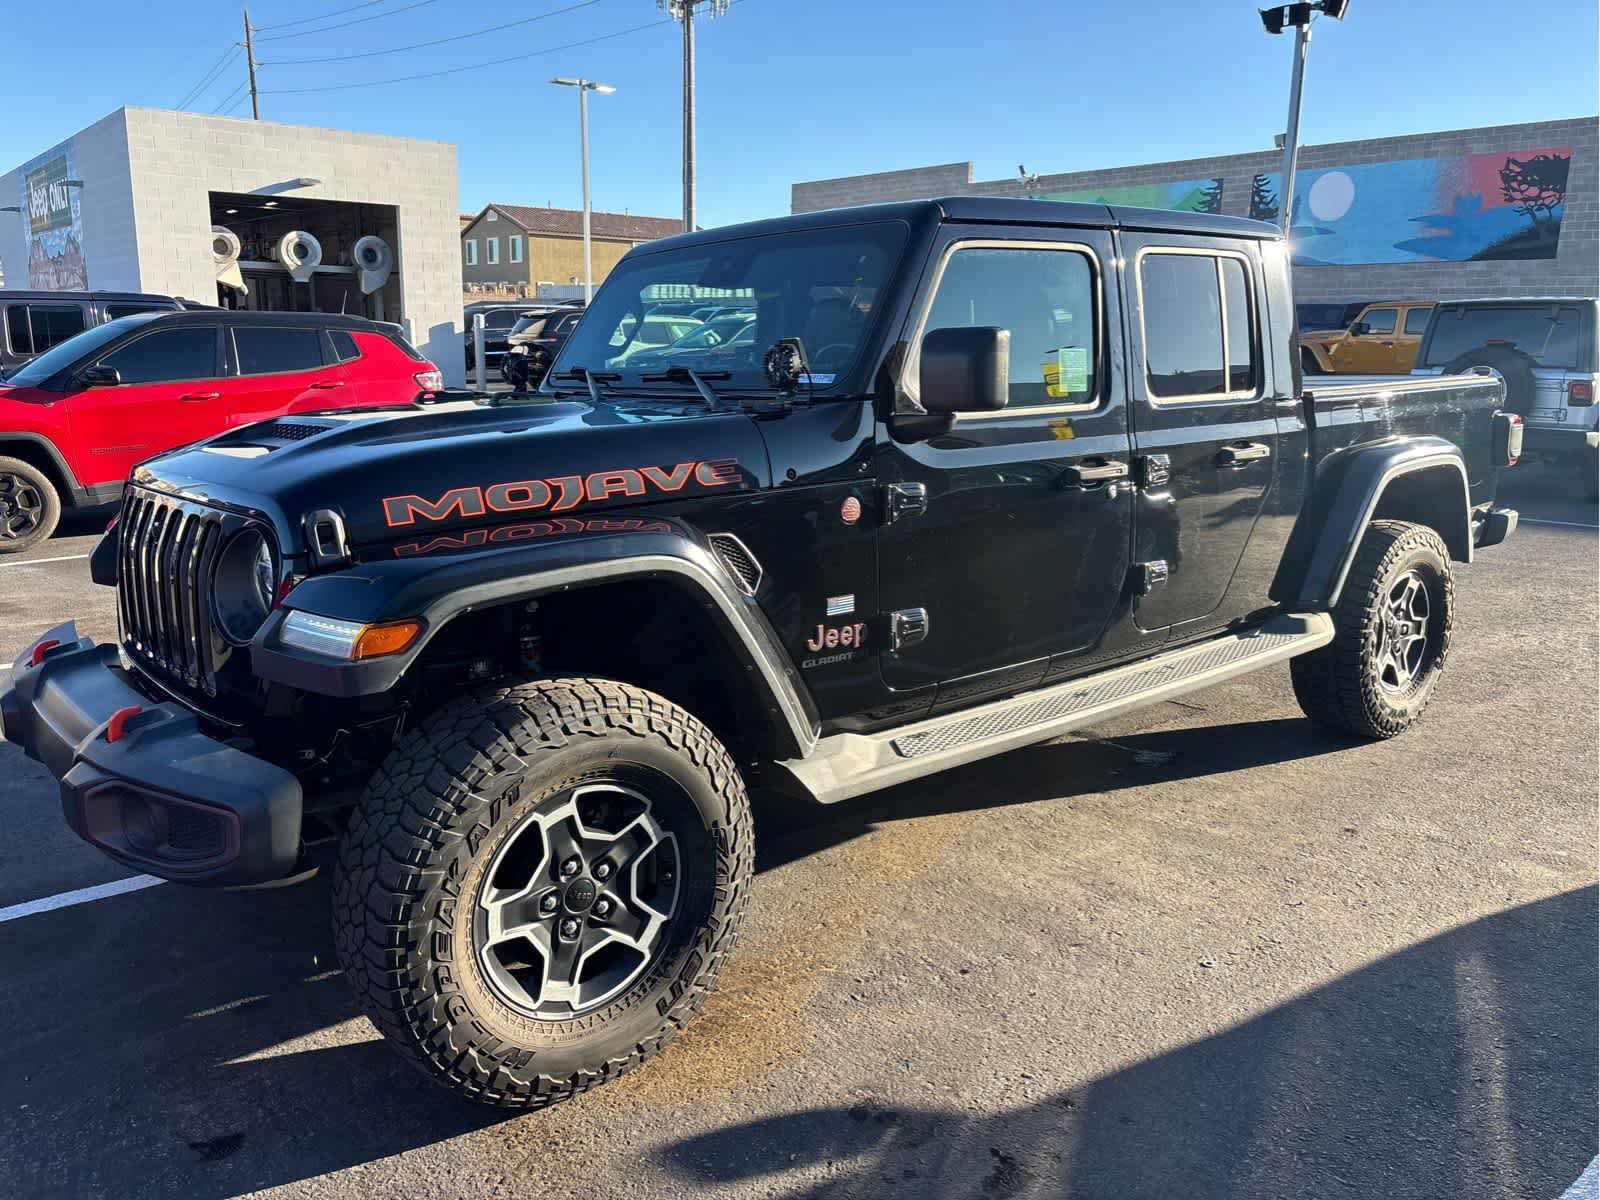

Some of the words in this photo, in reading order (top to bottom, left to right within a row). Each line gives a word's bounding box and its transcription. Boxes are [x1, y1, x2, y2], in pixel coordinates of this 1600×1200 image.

[29, 181, 48, 224] Jeep
[49, 177, 69, 212] ONLY
[383, 458, 742, 527] MOJAVE
[806, 622, 868, 652] Jeep
[431, 857, 546, 1069] WILDPEAK
